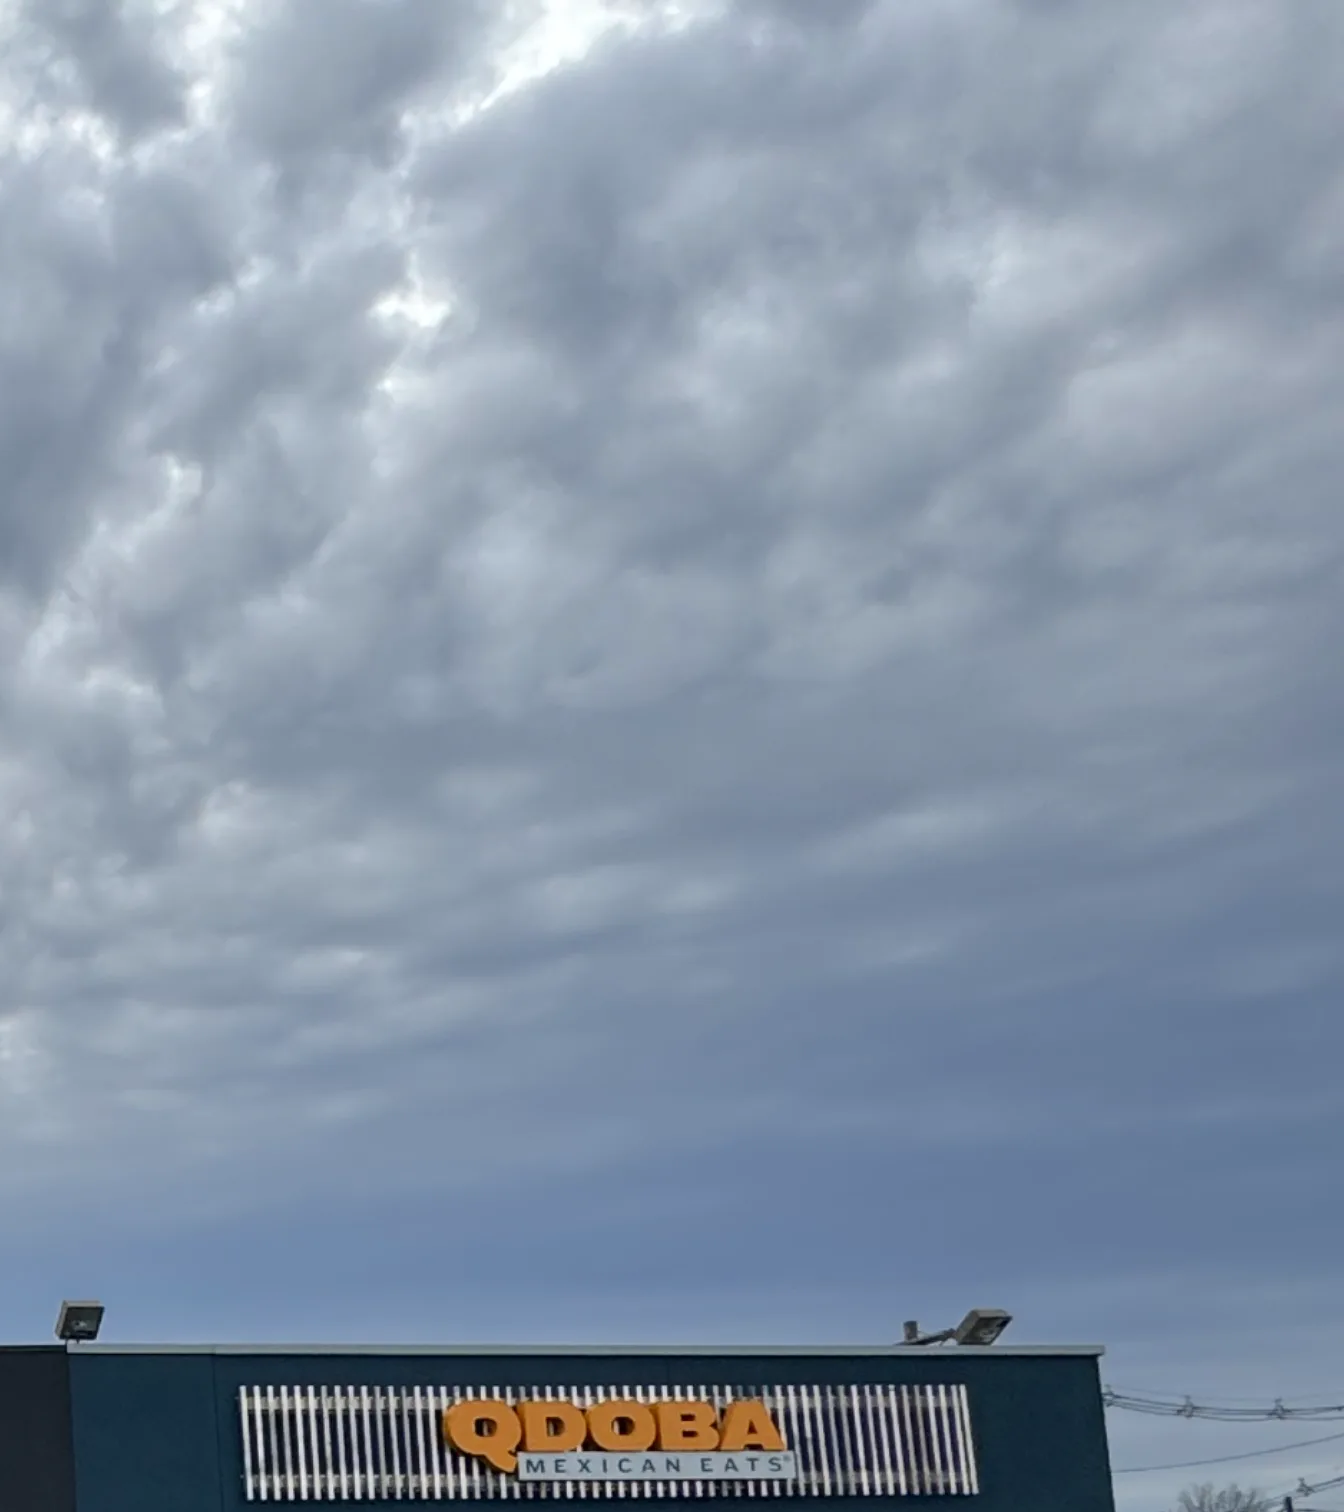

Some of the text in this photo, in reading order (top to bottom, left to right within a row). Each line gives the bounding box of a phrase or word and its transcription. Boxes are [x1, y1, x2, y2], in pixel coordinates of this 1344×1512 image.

[445, 1398, 786, 1473] QDOBA
[525, 1456, 784, 1474] MEXICAN EATS
